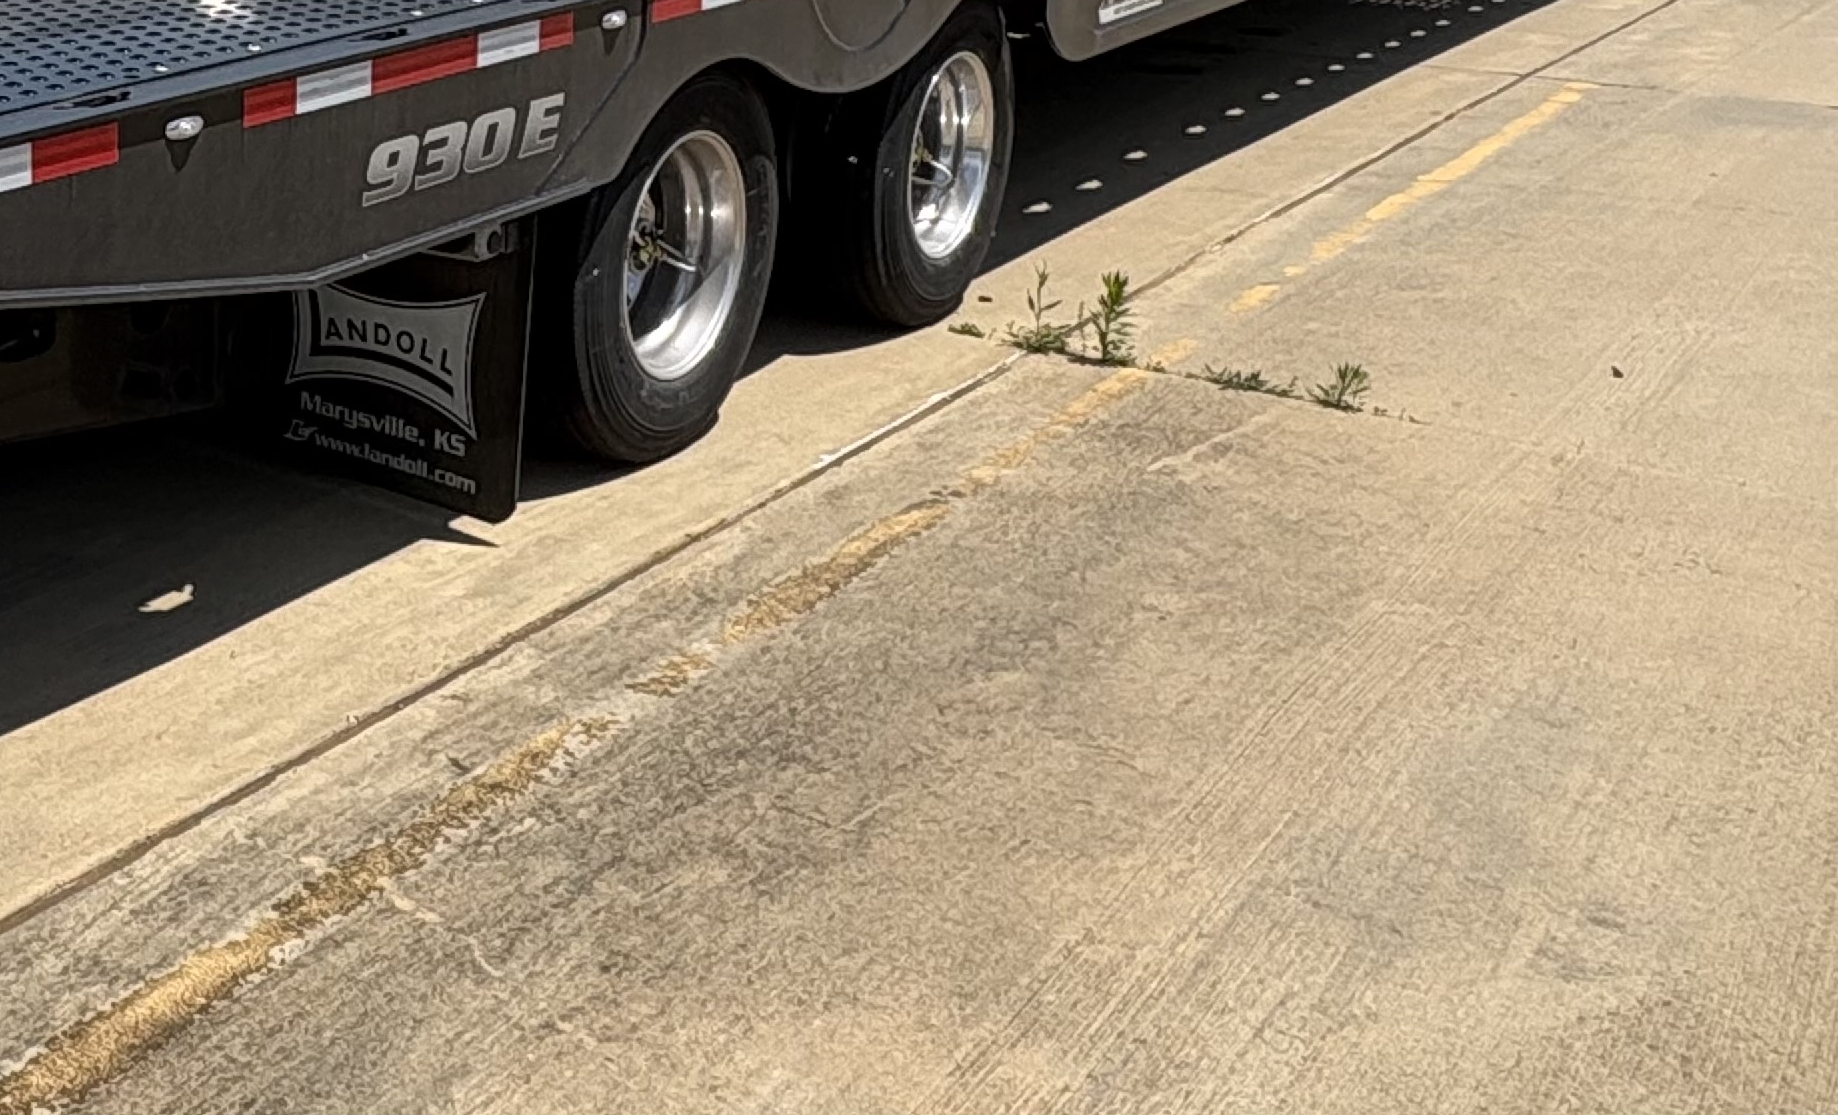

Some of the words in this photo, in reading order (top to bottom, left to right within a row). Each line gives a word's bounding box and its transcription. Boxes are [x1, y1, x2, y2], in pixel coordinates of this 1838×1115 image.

[361, 107, 516, 208] 930
[517, 92, 566, 160] E
[300, 391, 426, 447] Marysville,
[434, 428, 466, 457] KS
[315, 433, 476, 496] www.landoll.com
